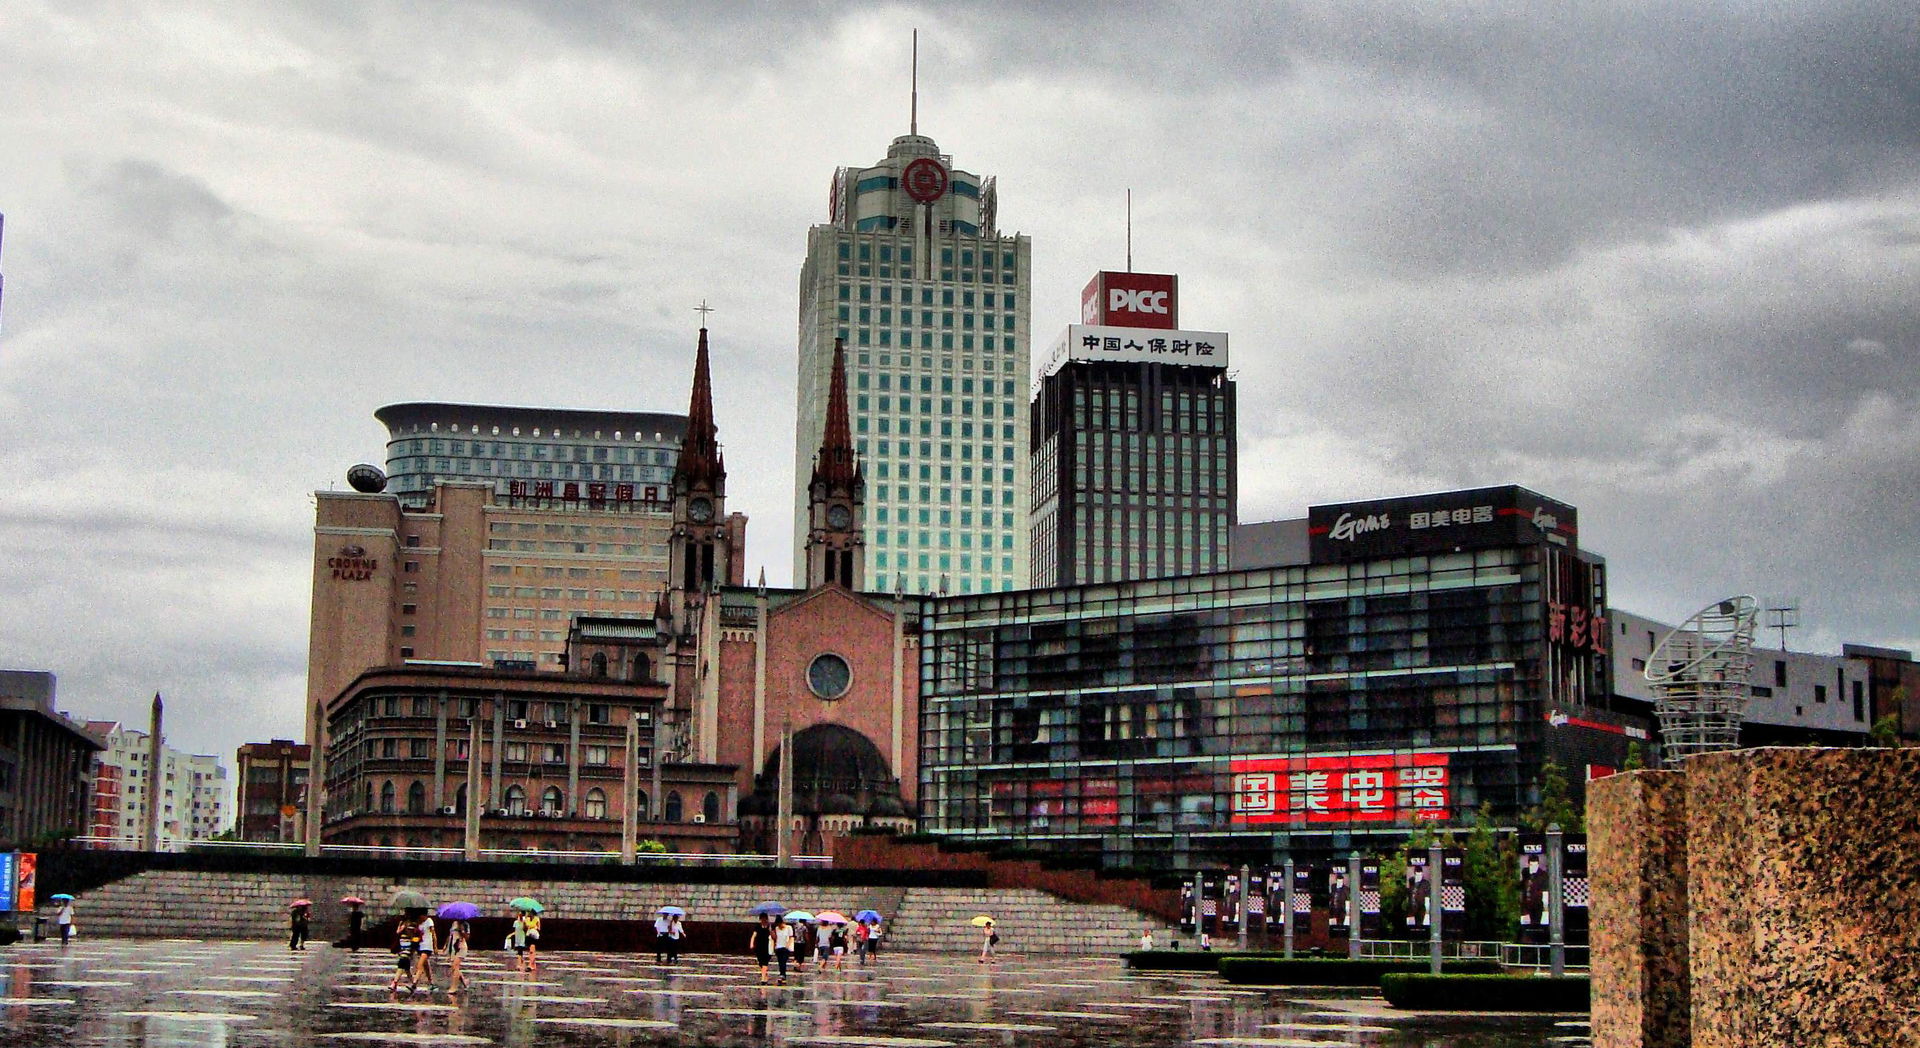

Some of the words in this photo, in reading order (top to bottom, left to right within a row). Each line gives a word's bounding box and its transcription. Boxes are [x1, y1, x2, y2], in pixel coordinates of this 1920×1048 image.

[1109, 288, 1168, 315] PICC
[1082, 335, 1215, 356] 中国人保财险
[509, 479, 675, 502] 凯洲皇冠假日
[1409, 505, 1494, 530] 国美电器
[328, 557, 377, 570] CROWNE
[333, 569, 372, 581] PLAZA
[1234, 767, 1445, 815] 国美电器
